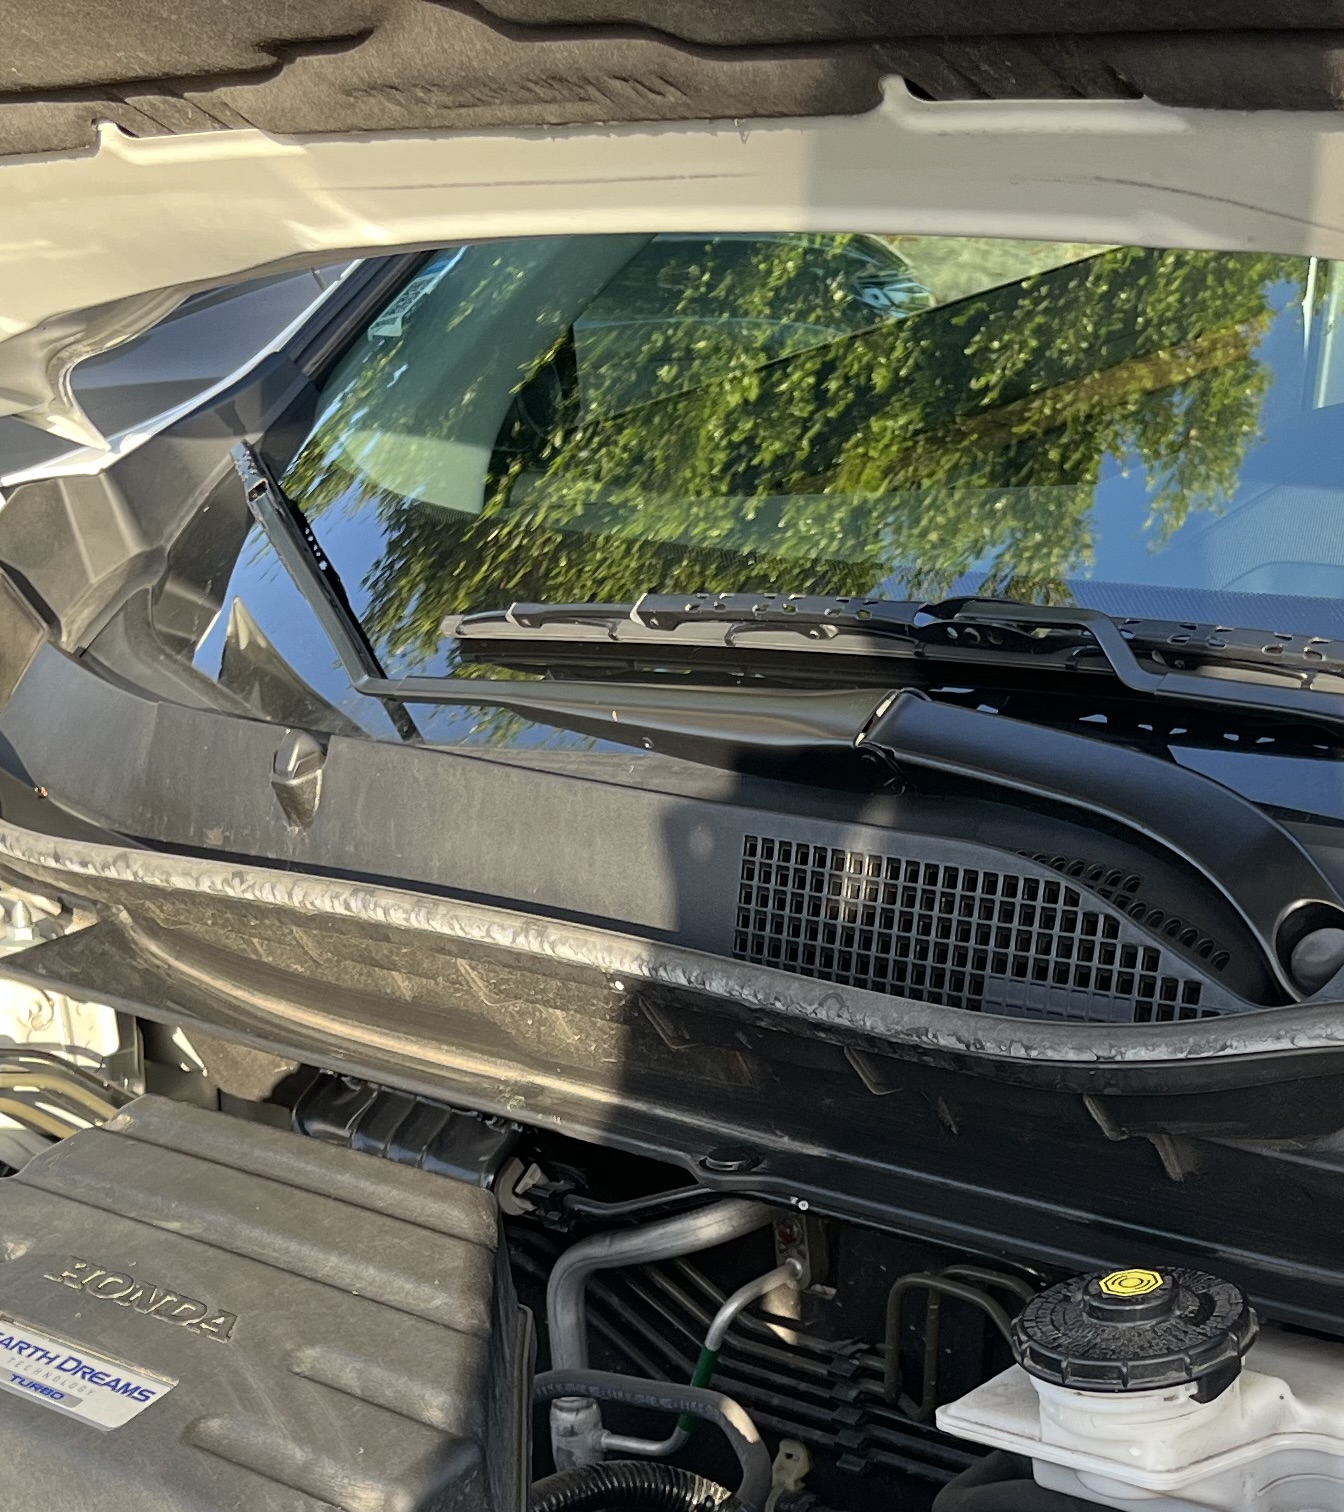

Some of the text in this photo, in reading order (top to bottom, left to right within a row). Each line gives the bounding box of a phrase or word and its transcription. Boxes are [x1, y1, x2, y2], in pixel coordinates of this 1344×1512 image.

[44, 1255, 238, 1343] HONDA
[7, 1357, 97, 1396] TECHNOLOGY
[9, 1372, 65, 1401] TURBO
[56, 1356, 156, 1404] DREAMS
